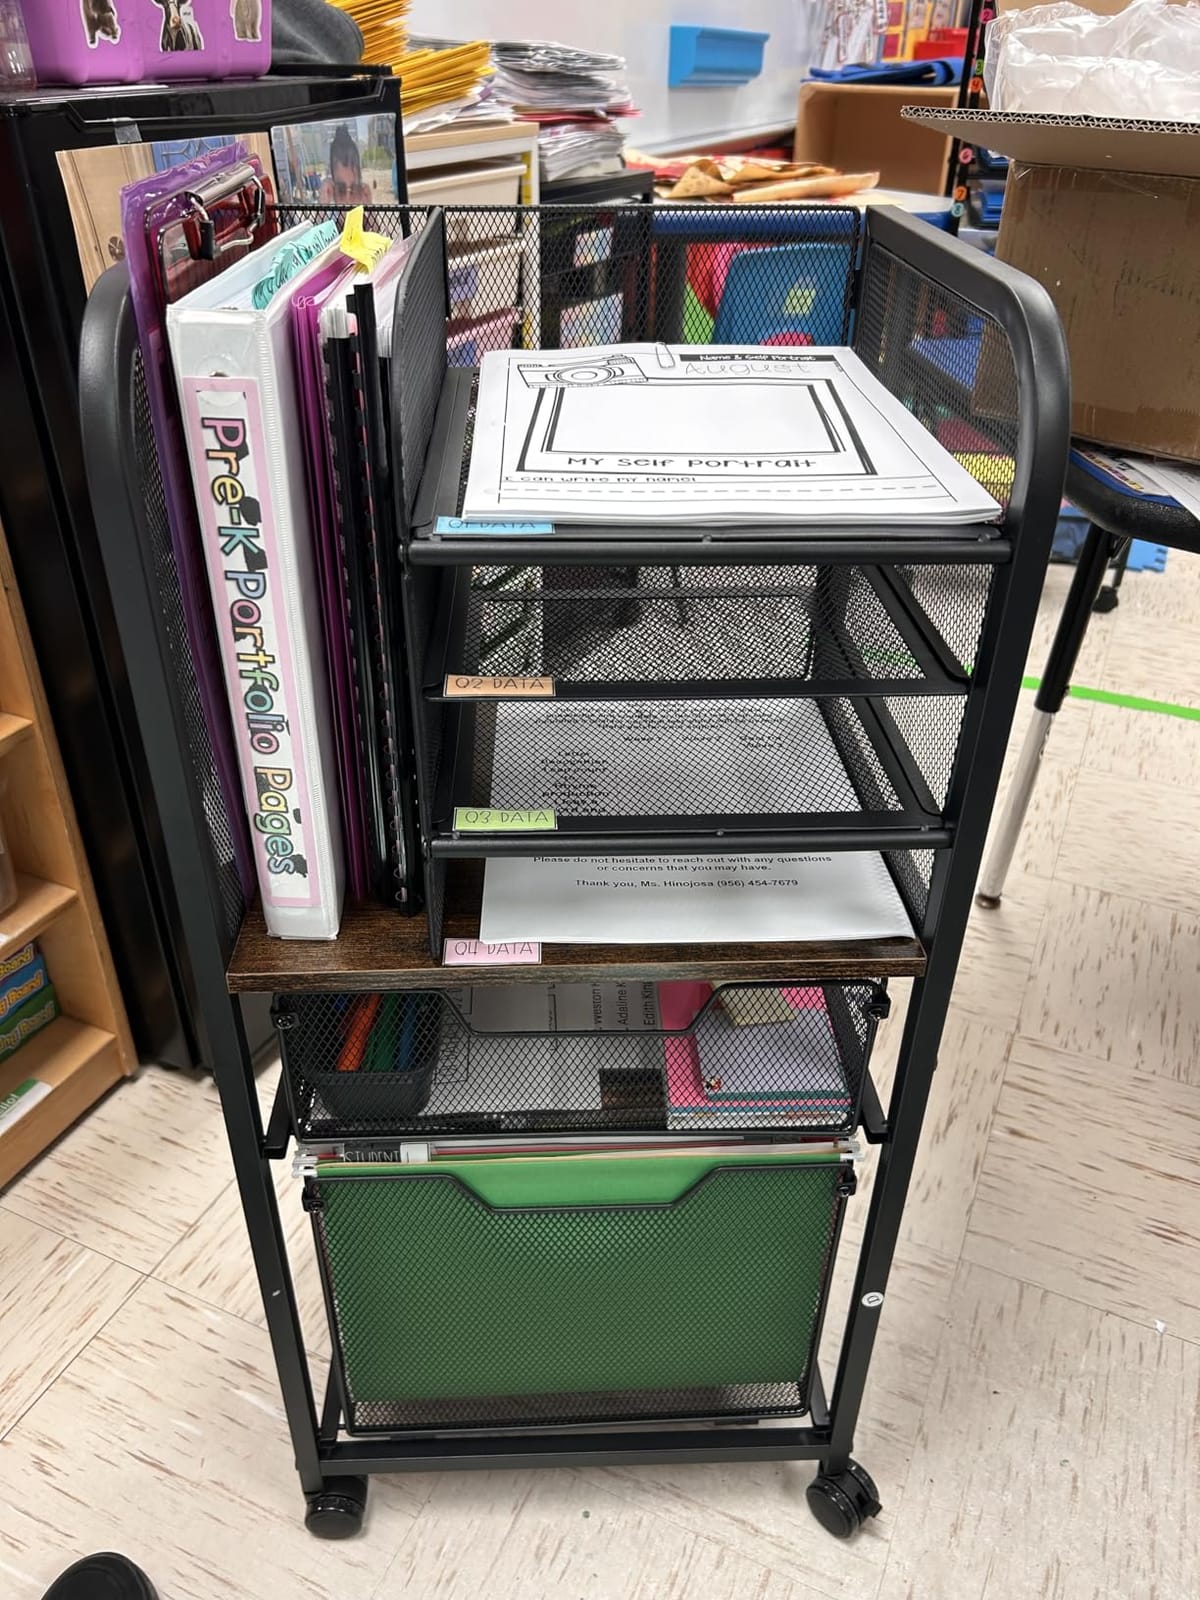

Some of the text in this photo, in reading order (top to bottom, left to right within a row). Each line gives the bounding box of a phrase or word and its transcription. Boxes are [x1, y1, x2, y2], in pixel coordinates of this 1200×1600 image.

[700, 353, 731, 361] Name
[745, 353, 768, 361] Self
[685, 362, 810, 376] August
[617, 458, 675, 467] self
[688, 459, 817, 468] portrait
[201, 417, 296, 876] Pre-K Portfolio Pages
[455, 677, 545, 689] Q2 DATA
[465, 811, 549, 824] Q3 DATA
[777, 855, 832, 864] questions
[576, 879, 610, 887] Thank
[663, 880, 714, 888] Hinojosa
[717, 879, 744, 888] (956)
[455, 941, 533, 955] Q4 DATA
[616, 989, 629, 1025] Adaline
[642, 1001, 656, 1025] Edith
[344, 1150, 400, 1162] STUDENT
